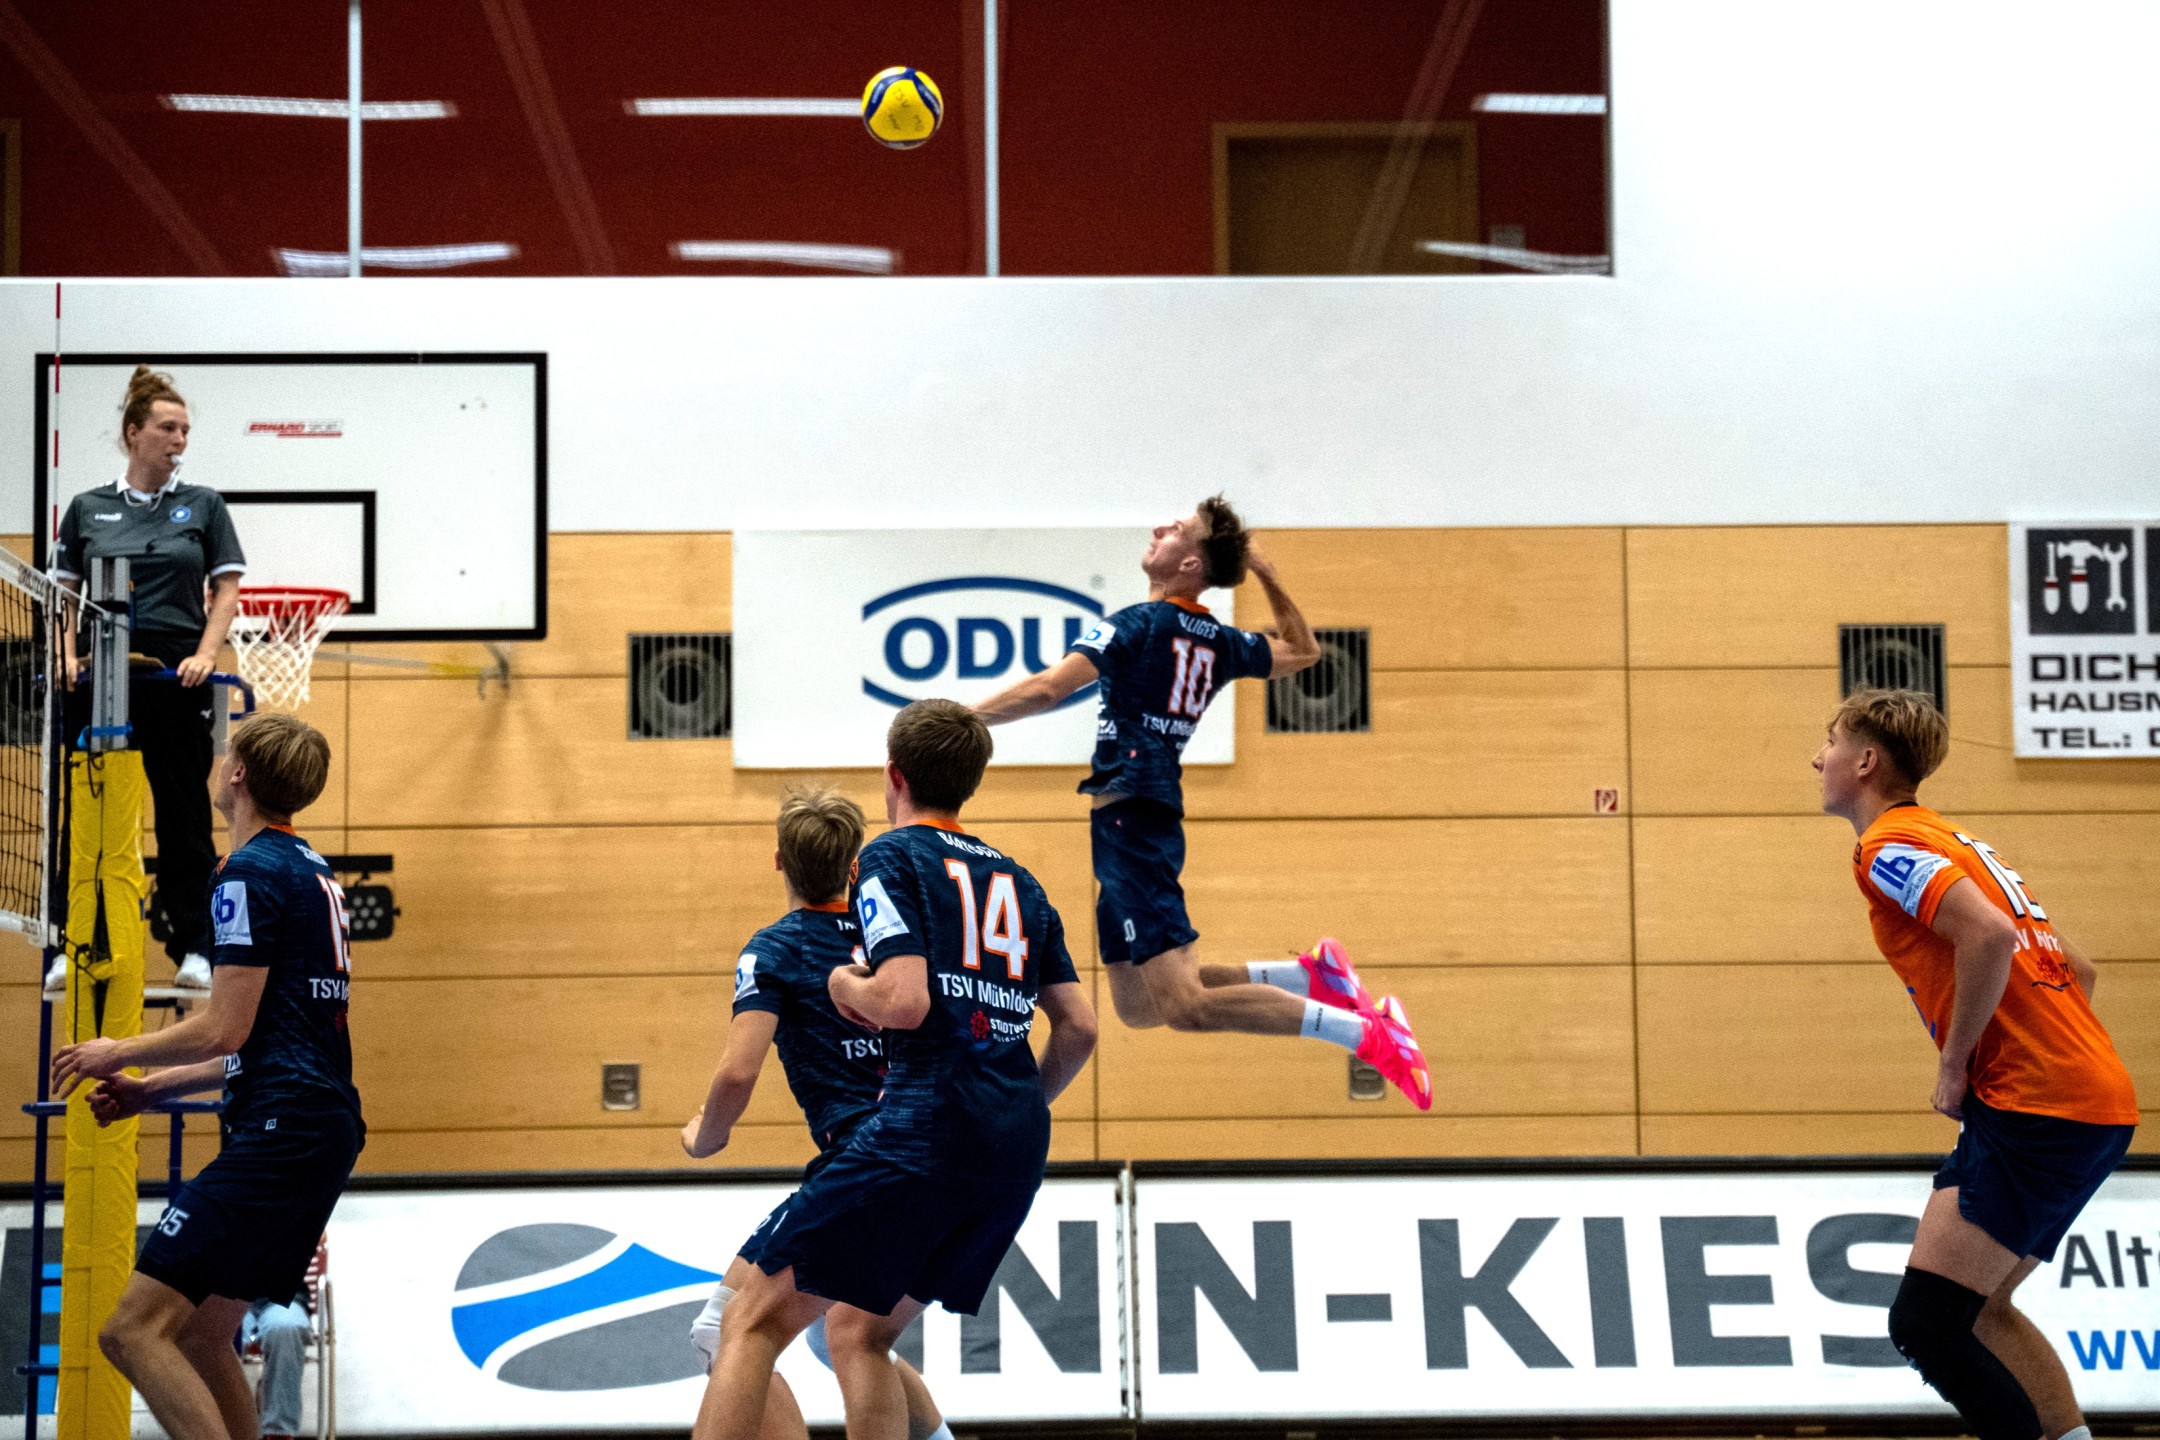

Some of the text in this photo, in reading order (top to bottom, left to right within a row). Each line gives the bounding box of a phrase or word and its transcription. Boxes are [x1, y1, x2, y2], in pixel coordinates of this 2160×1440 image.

[884, 616, 1083, 682] ODU
[1168, 637, 1216, 719] 10
[1141, 713, 1170, 735] TSV
[2032, 727, 2131, 749] TEL.:
[944, 858, 1028, 981] 14
[309, 978, 340, 999] TSV
[938, 973, 973, 999] TSV
[158, 1206, 190, 1237] 15
[2060, 1229, 2160, 1289] Alt
